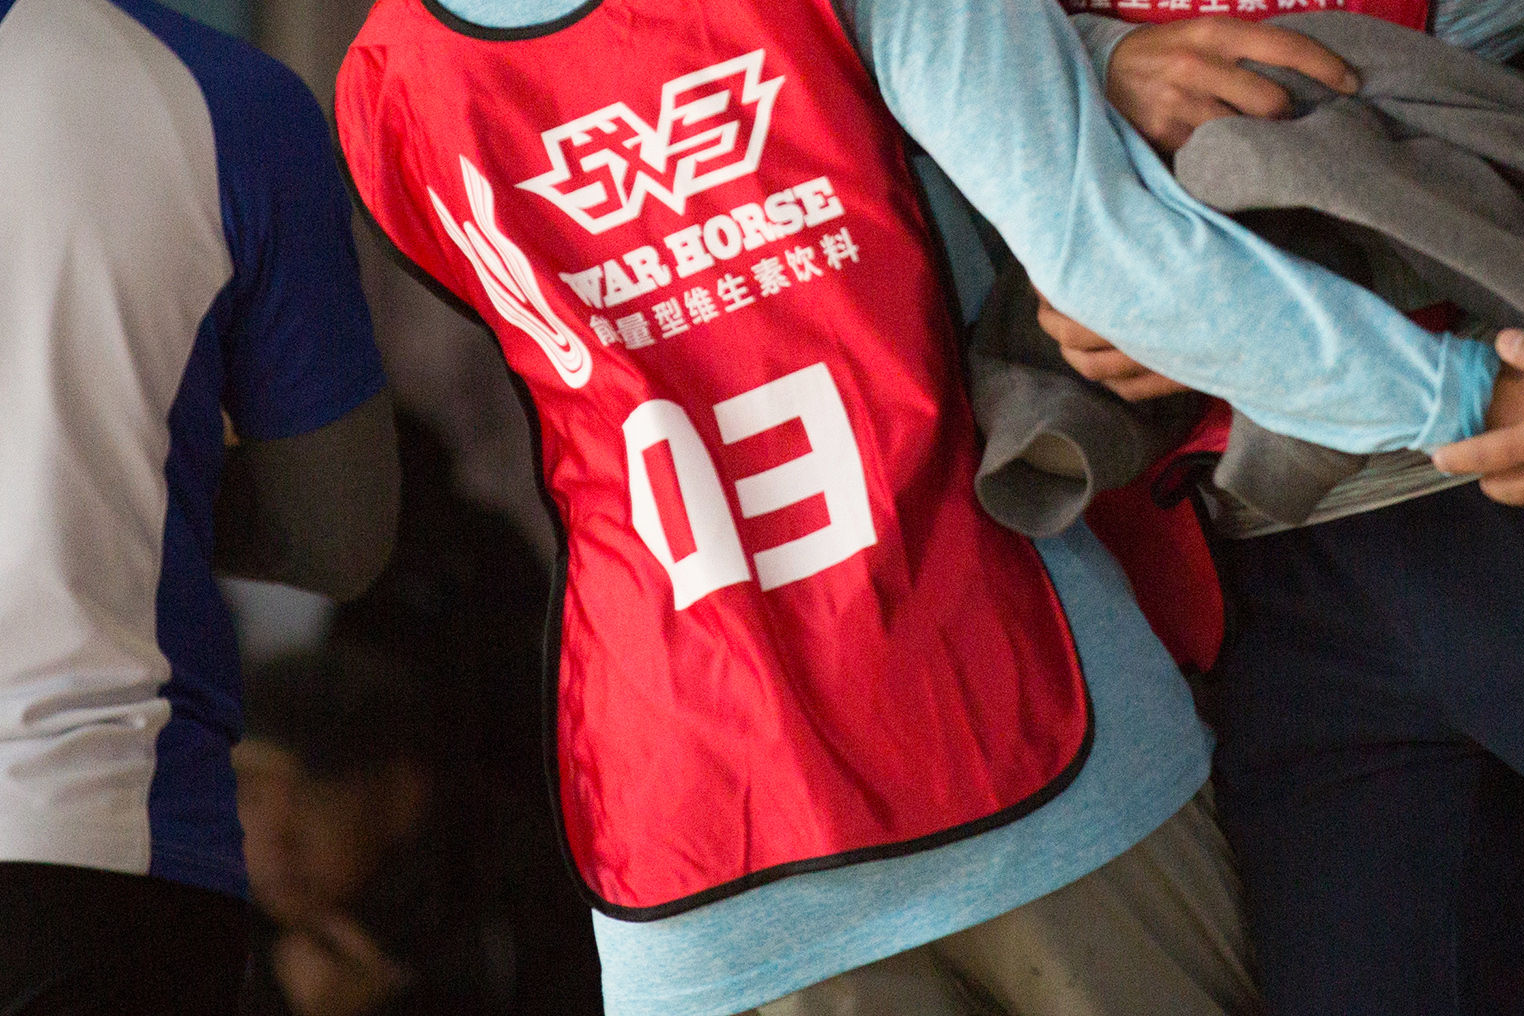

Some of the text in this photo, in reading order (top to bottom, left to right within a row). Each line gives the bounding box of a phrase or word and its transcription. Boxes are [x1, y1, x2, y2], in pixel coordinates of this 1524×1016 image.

[558, 175, 845, 310] WAR HORSE
[622, 361, 878, 611] 03
